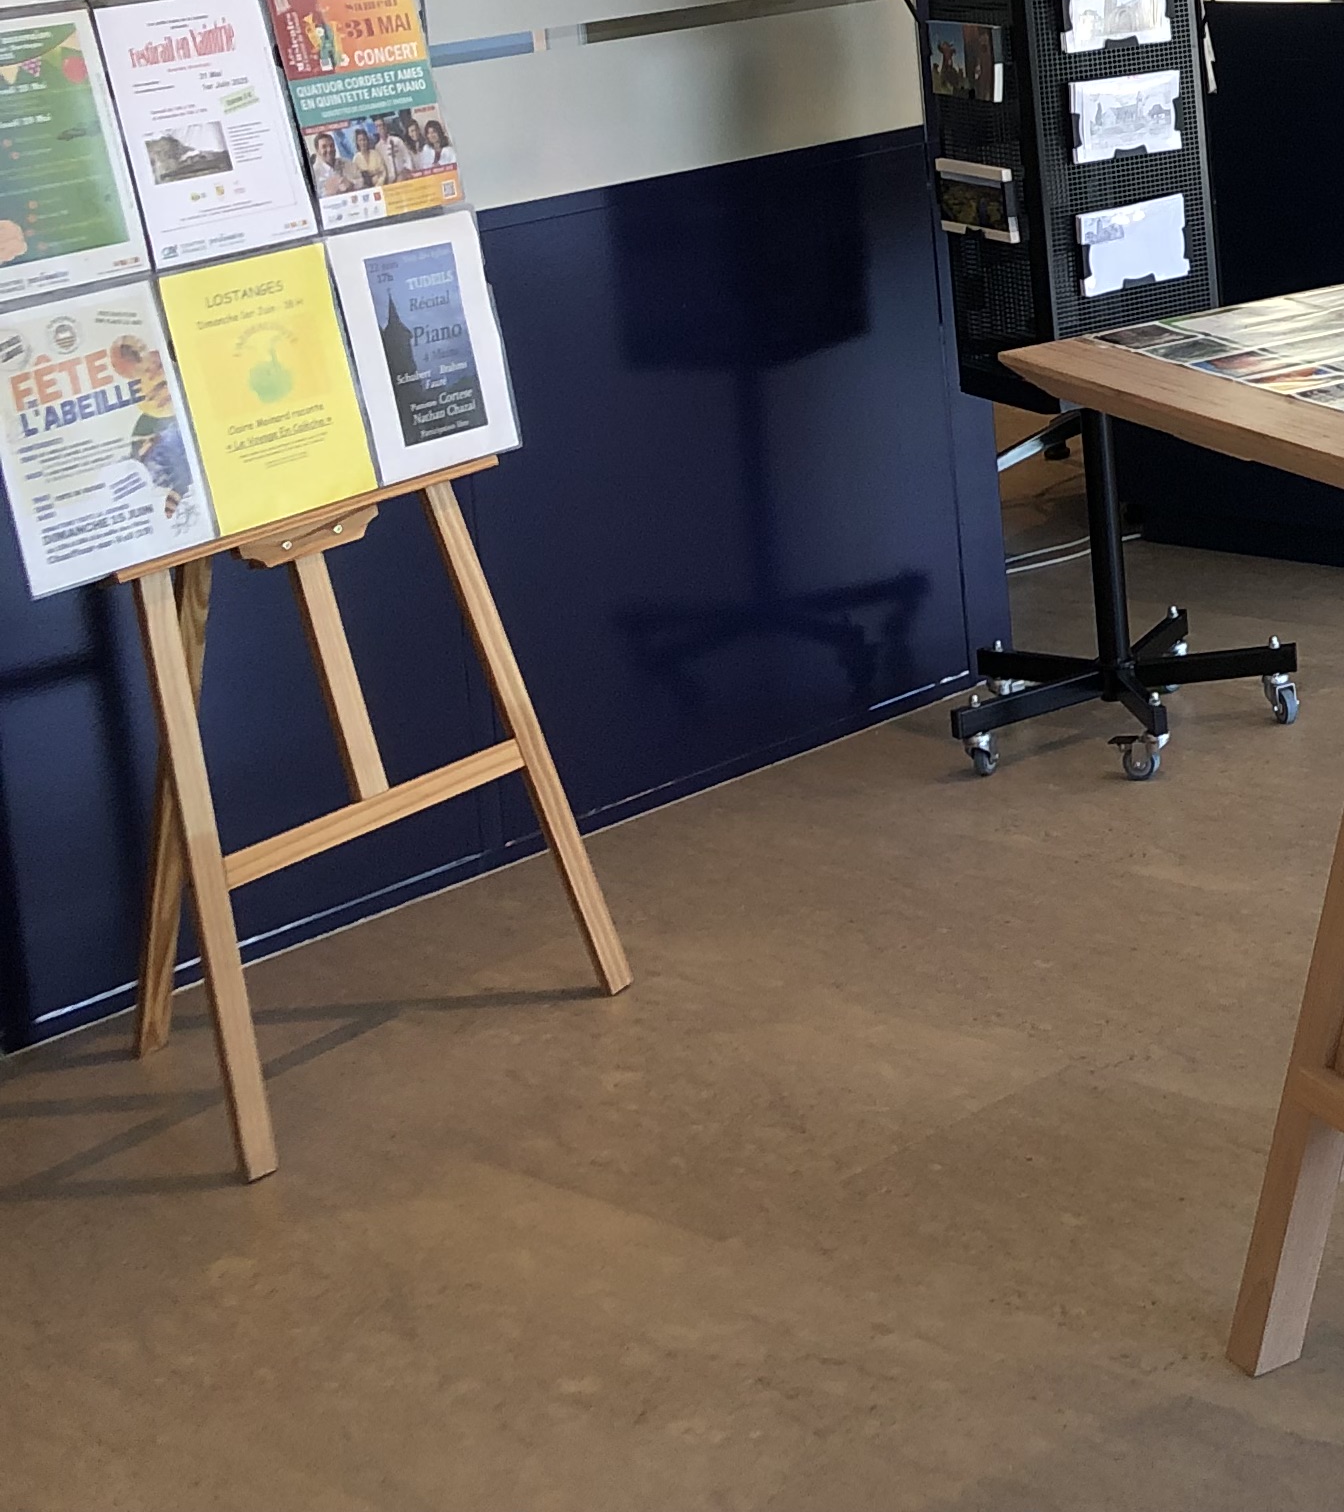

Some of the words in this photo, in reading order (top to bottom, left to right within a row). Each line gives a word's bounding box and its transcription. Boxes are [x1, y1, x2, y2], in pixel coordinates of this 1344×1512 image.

[346, 16, 375, 39] 31
[378, 12, 412, 34] MAI
[353, 41, 419, 67] CONCERT
[296, 79, 345, 97] QUATUOR
[345, 74, 383, 90] CORDES
[385, 71, 395, 83] ET
[397, 66, 424, 81] AMES
[300, 97, 316, 111] EN
[317, 90, 370, 107] QUINTETTE
[371, 85, 396, 99] AVEC
[397, 79, 426, 95] PIANO
[205, 280, 284, 308] LOSTANGES
[409, 290, 450, 311] Récital
[413, 323, 463, 347] Piano
[10, 348, 114, 413] FÊTE
[396, 370, 432, 385] Schubert
[18, 378, 146, 437] L'ABEILLE
